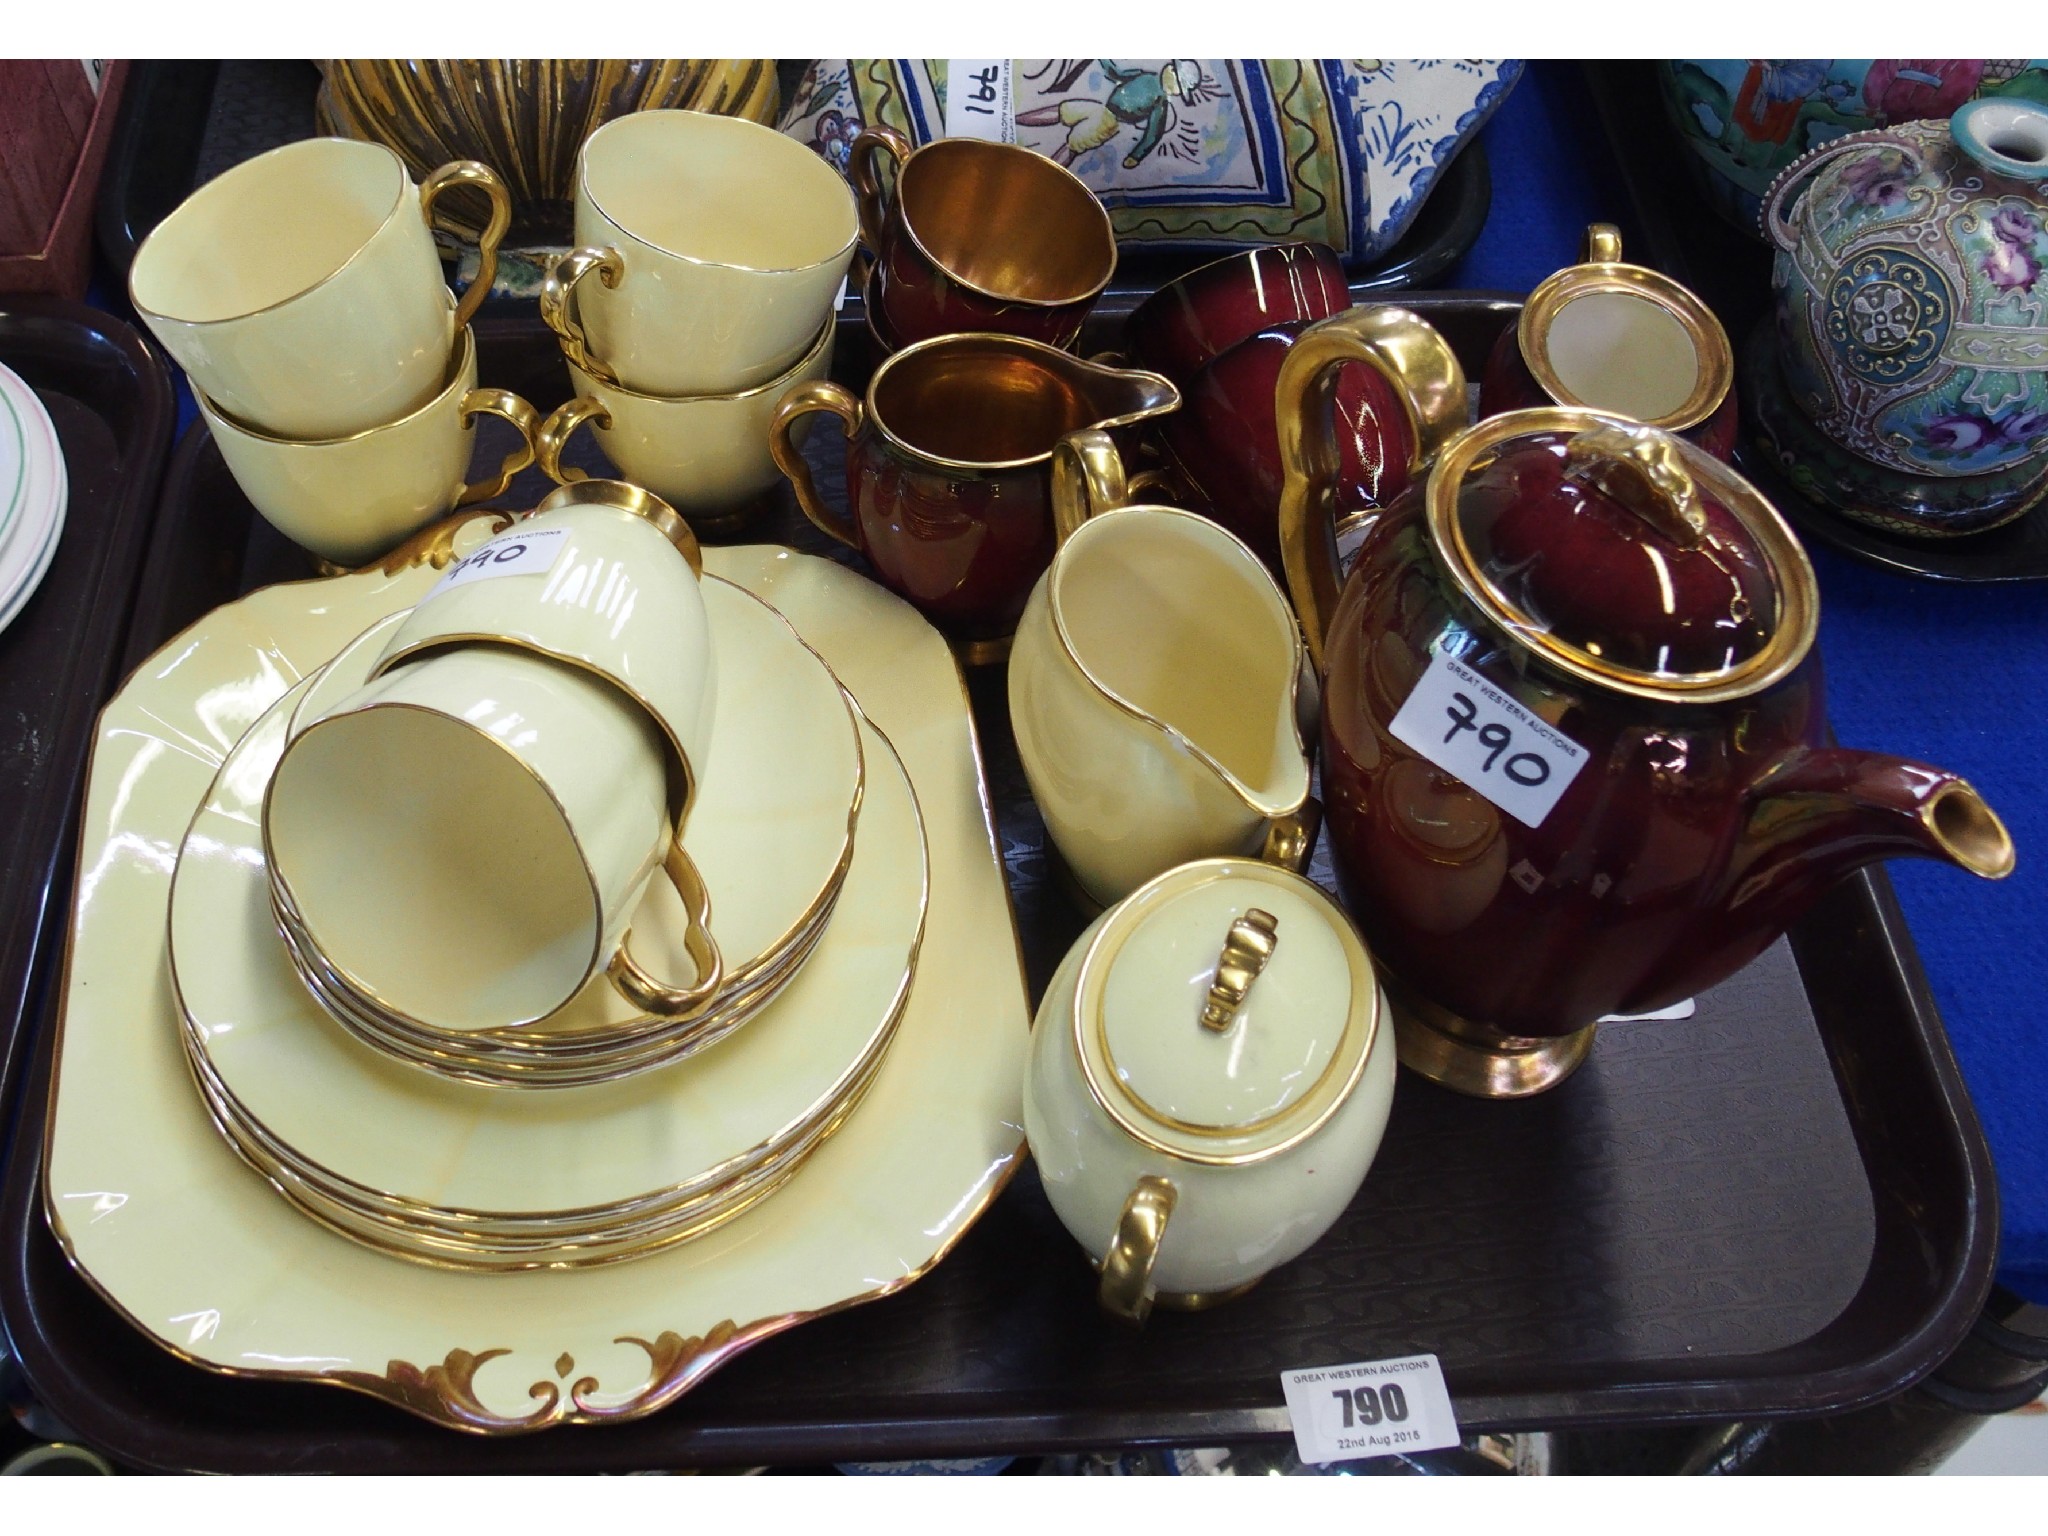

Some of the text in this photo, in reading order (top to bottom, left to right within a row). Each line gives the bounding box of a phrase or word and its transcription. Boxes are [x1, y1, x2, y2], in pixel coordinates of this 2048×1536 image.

[965, 65, 999, 115] 791
[514, 529, 562, 539] AUCTIONS
[448, 544, 528, 581] 790
[1446, 661, 1577, 757] GREAT WESTERN AUCTIONS
[1443, 692, 1550, 787] 790
[1293, 1360, 1430, 1384] GREAT WESTERN AUCTIONS
[1332, 1382, 1410, 1429] 790
[1337, 1434, 1366, 1449] 22nd
[1369, 1433, 1391, 1447] Aug
